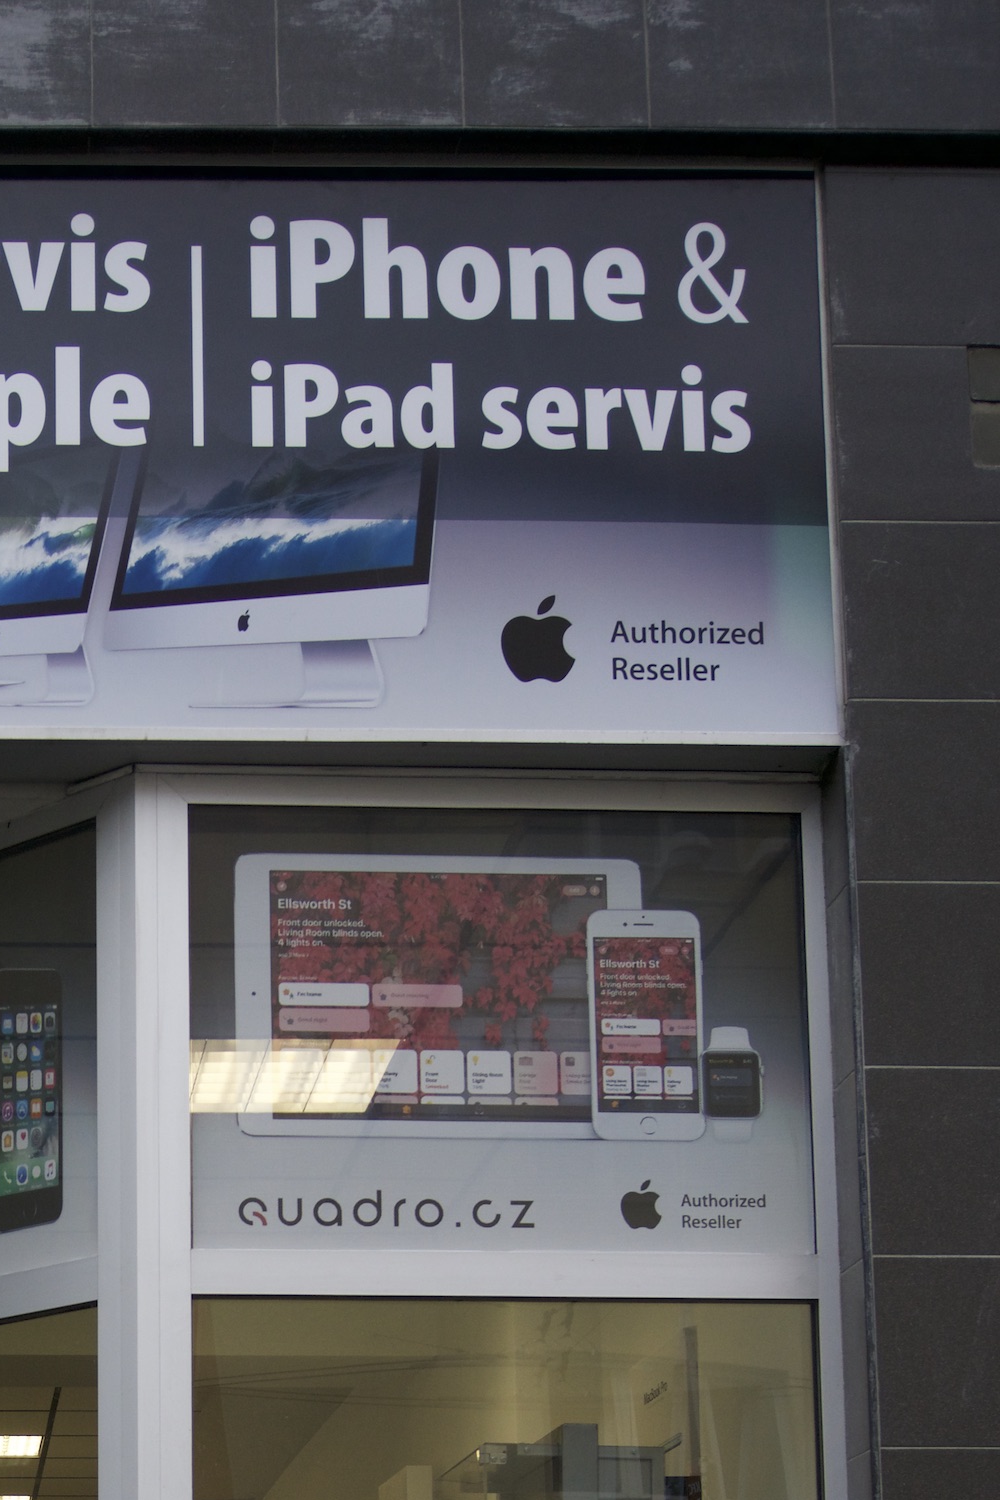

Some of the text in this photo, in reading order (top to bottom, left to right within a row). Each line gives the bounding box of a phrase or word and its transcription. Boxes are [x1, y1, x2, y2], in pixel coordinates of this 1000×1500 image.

[249, 215, 749, 324] iPhone &
[250, 359, 752, 454] iPad servis
[610, 618, 764, 646] Authorized
[611, 657, 720, 682] Reseller
[277, 898, 353, 910] Ellsworth St
[277, 918, 366, 928] Front door unlocked.
[277, 928, 304, 938] Living
[305, 929, 331, 937] Room
[332, 929, 359, 937] blinds
[277, 938, 284, 946] 4
[286, 938, 310, 947] lights
[599, 959, 660, 969] Ellsworth St
[680, 1192, 767, 1208] Authorized
[681, 1213, 742, 1229] Reseller
